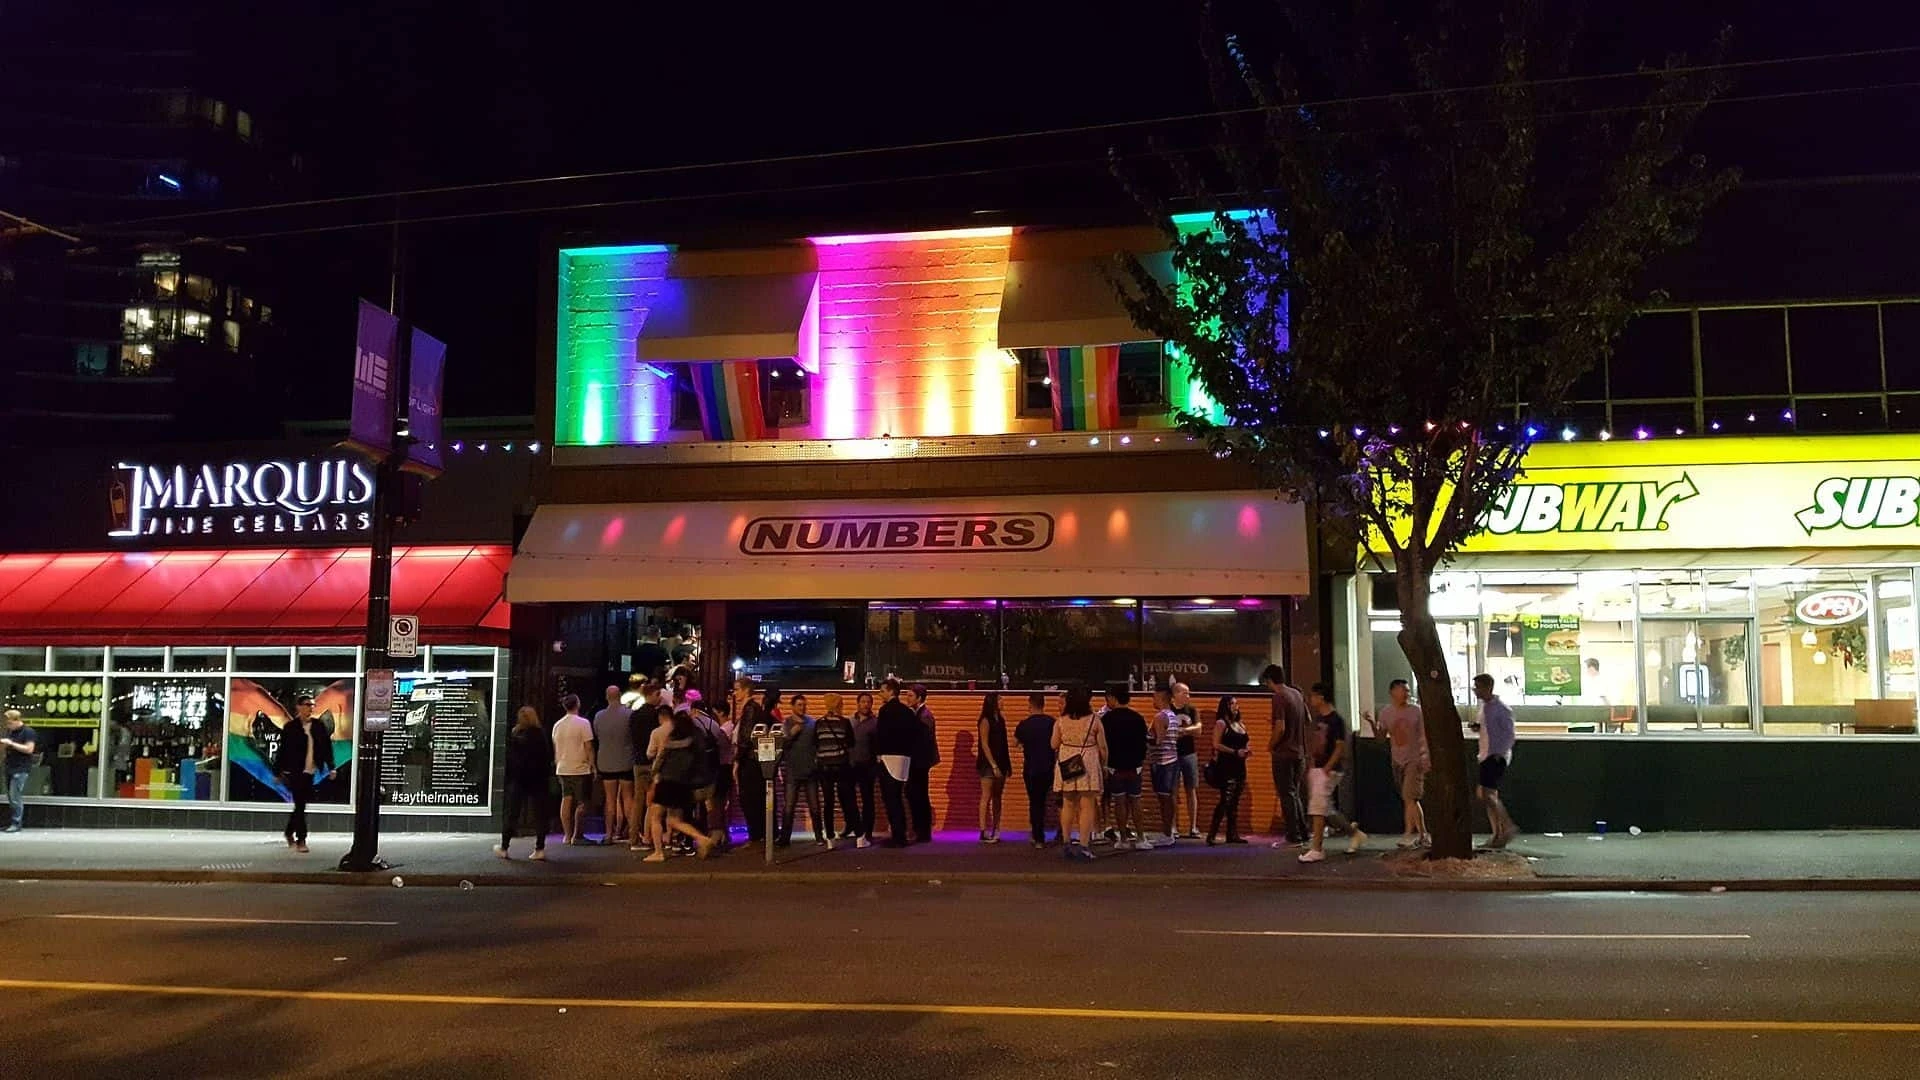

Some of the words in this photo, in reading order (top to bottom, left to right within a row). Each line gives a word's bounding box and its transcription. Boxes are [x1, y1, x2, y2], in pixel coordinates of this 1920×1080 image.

[140, 461, 373, 516] MARQUIS
[1474, 472, 1700, 535] UBWAY
[1794, 476, 1920, 536] SUB
[232, 512, 370, 533] CELLARS
[752, 518, 1036, 549] NUMBERS
[1805, 596, 1860, 617] OPEN
[392, 790, 479, 806] #saytheirnames
